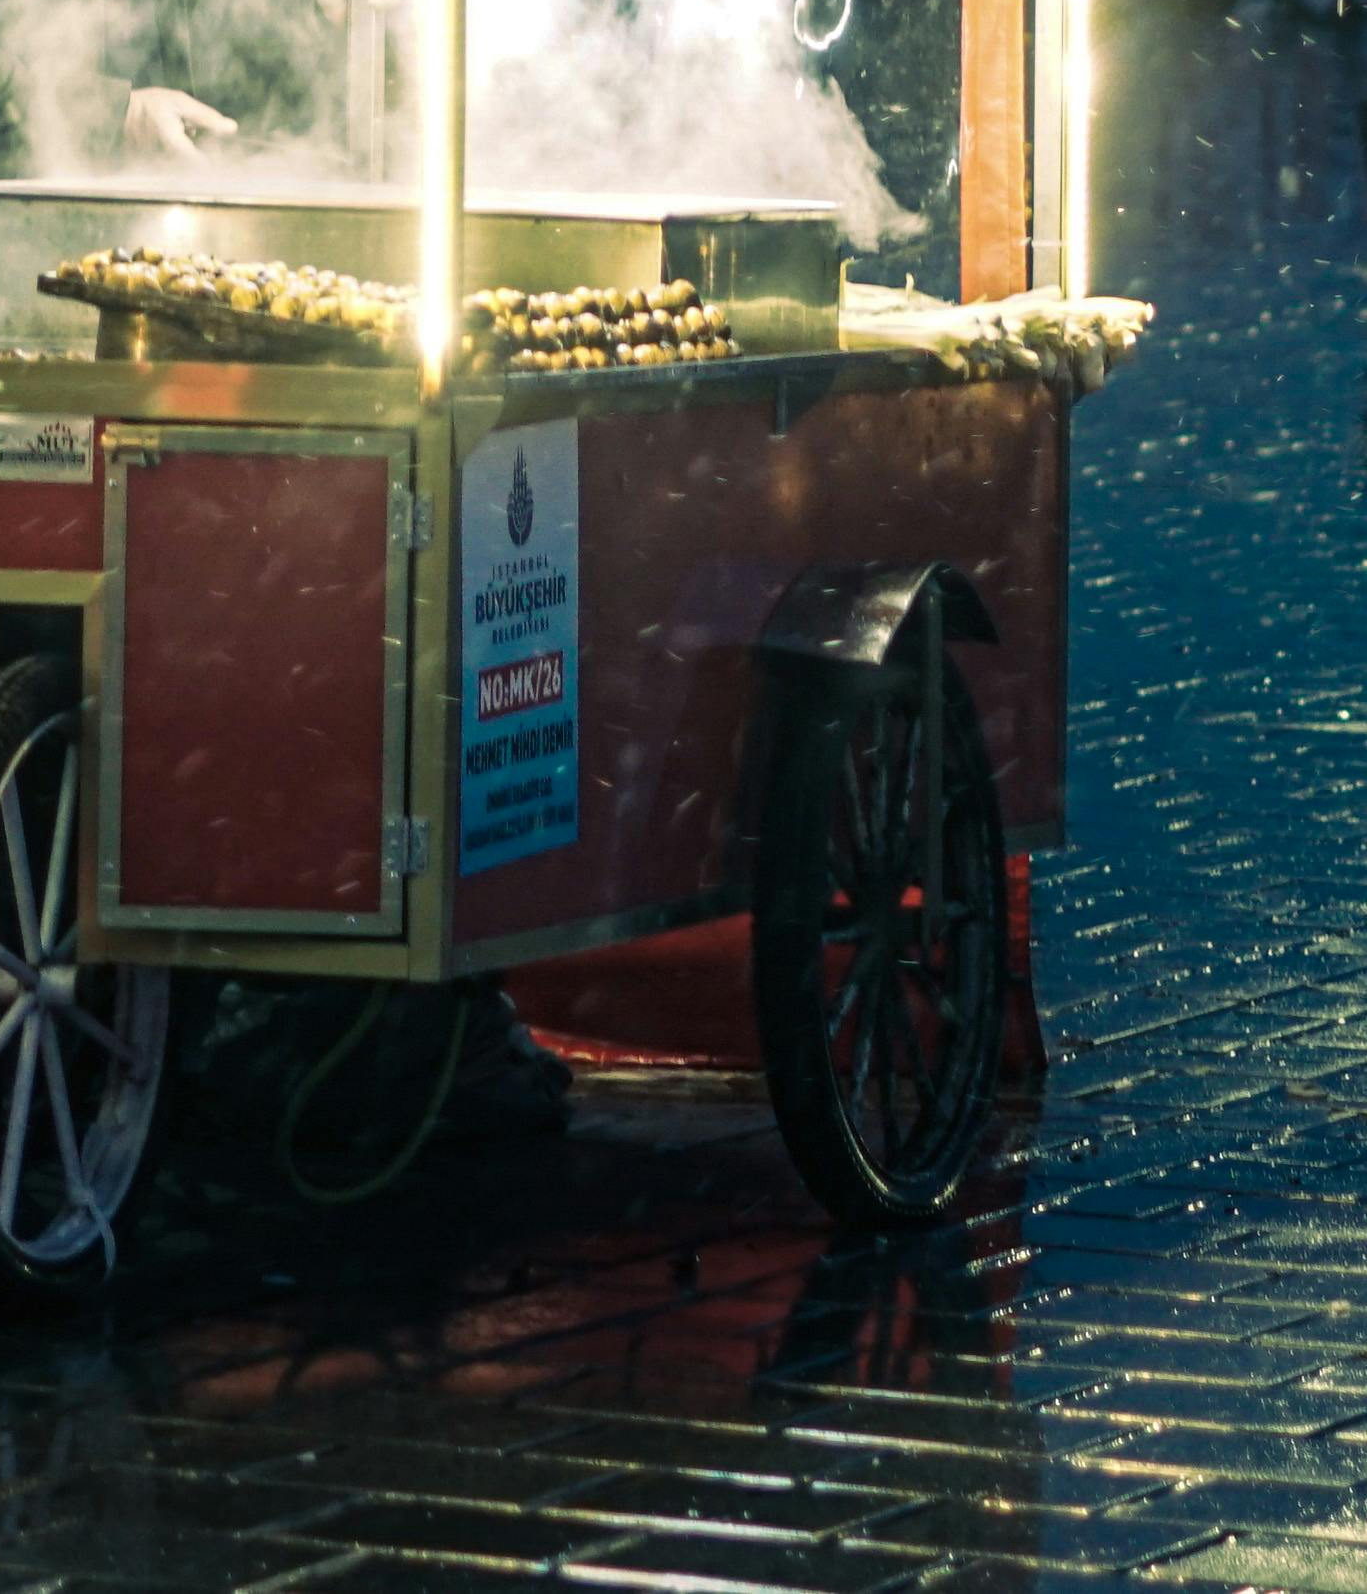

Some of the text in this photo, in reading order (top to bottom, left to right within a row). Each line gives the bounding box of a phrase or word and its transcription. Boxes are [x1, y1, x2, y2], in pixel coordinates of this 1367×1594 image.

[475, 567, 567, 622] BÜYÜKŞEHİR
[480, 657, 561, 714] NO:MK/26
[465, 735, 509, 775] MEHMET
[543, 709, 575, 755] DEMİR
